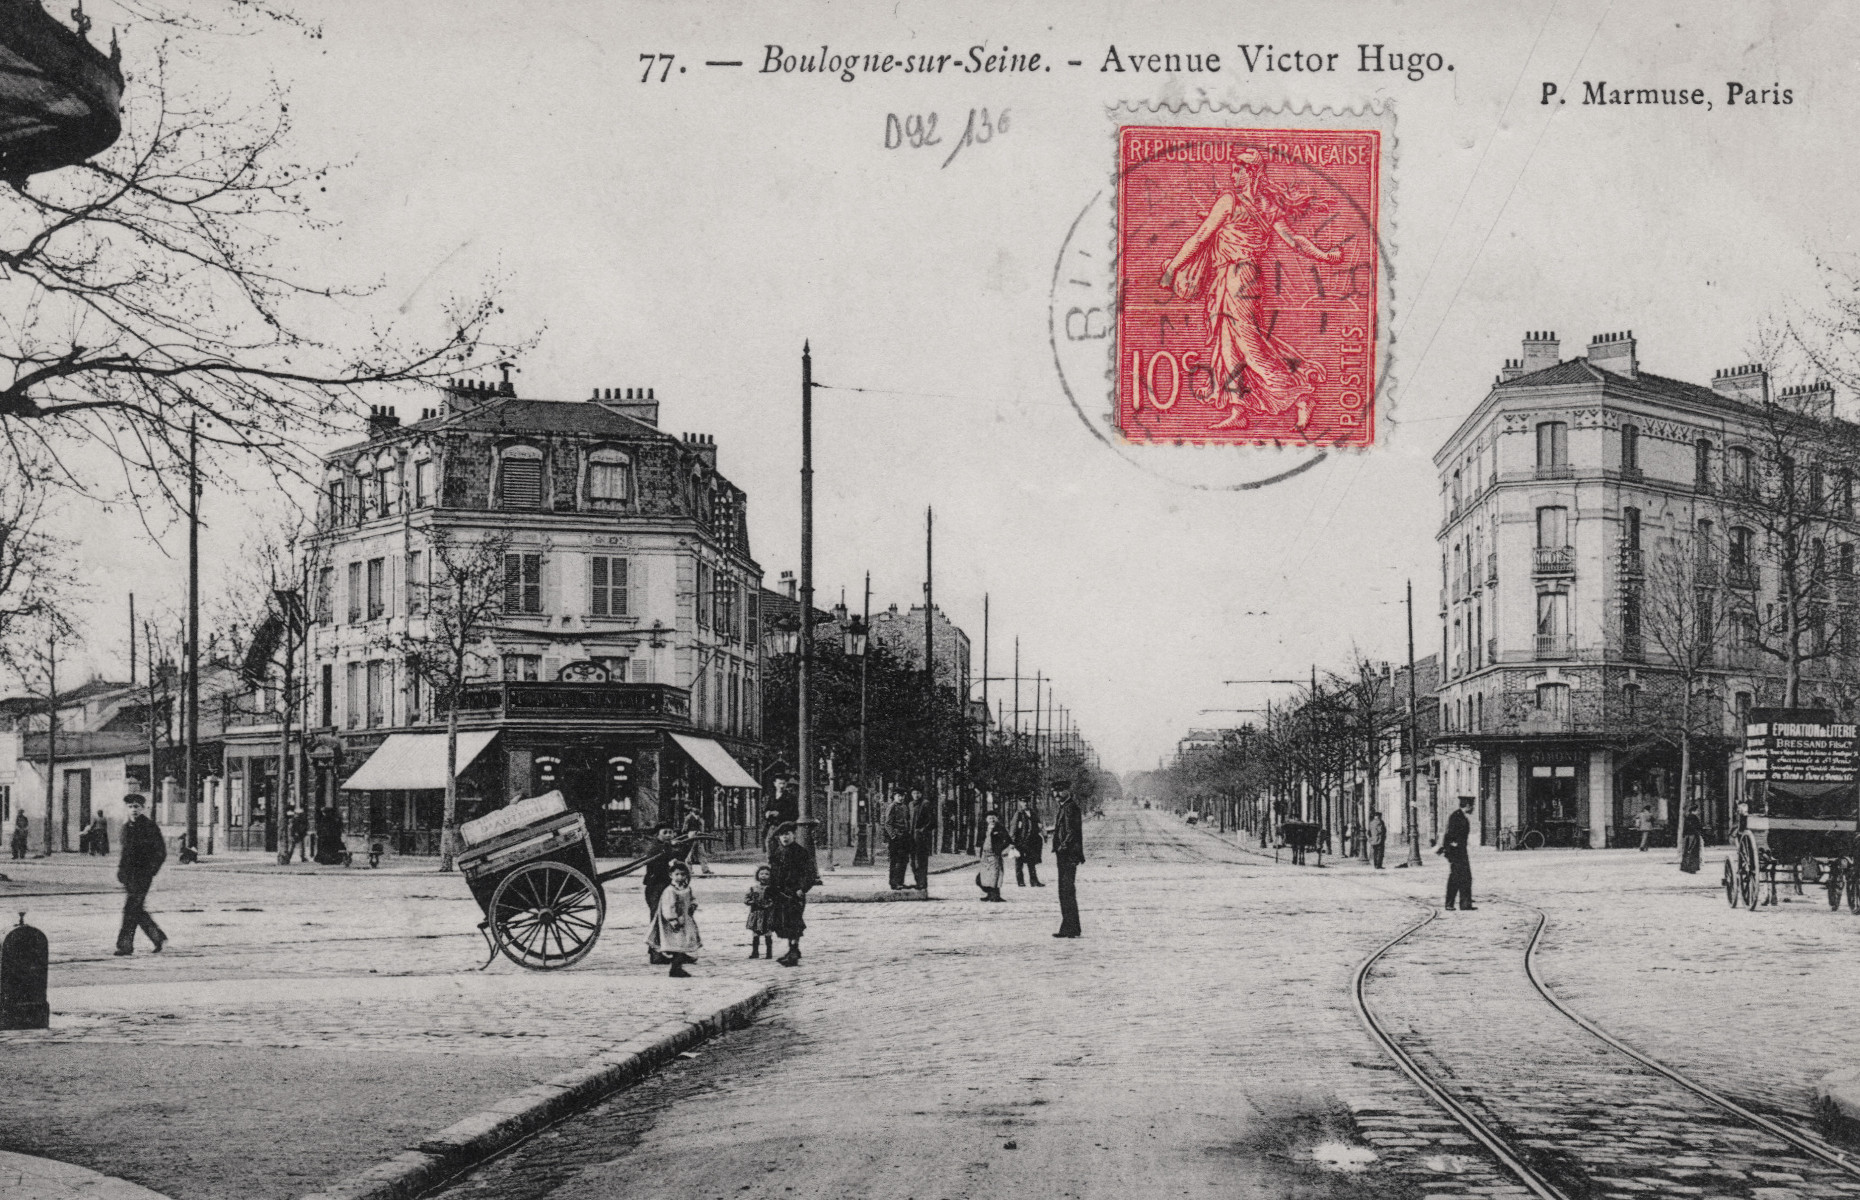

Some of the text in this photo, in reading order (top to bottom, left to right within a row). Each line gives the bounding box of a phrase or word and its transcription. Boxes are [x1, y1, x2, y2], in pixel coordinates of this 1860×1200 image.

[1268, 143, 1368, 166] FRANÇAISE
[1338, 325, 1365, 427] POSTES
[1826, 724, 1858, 738] LITERIE
[1776, 738, 1827, 749] BRESSAND
